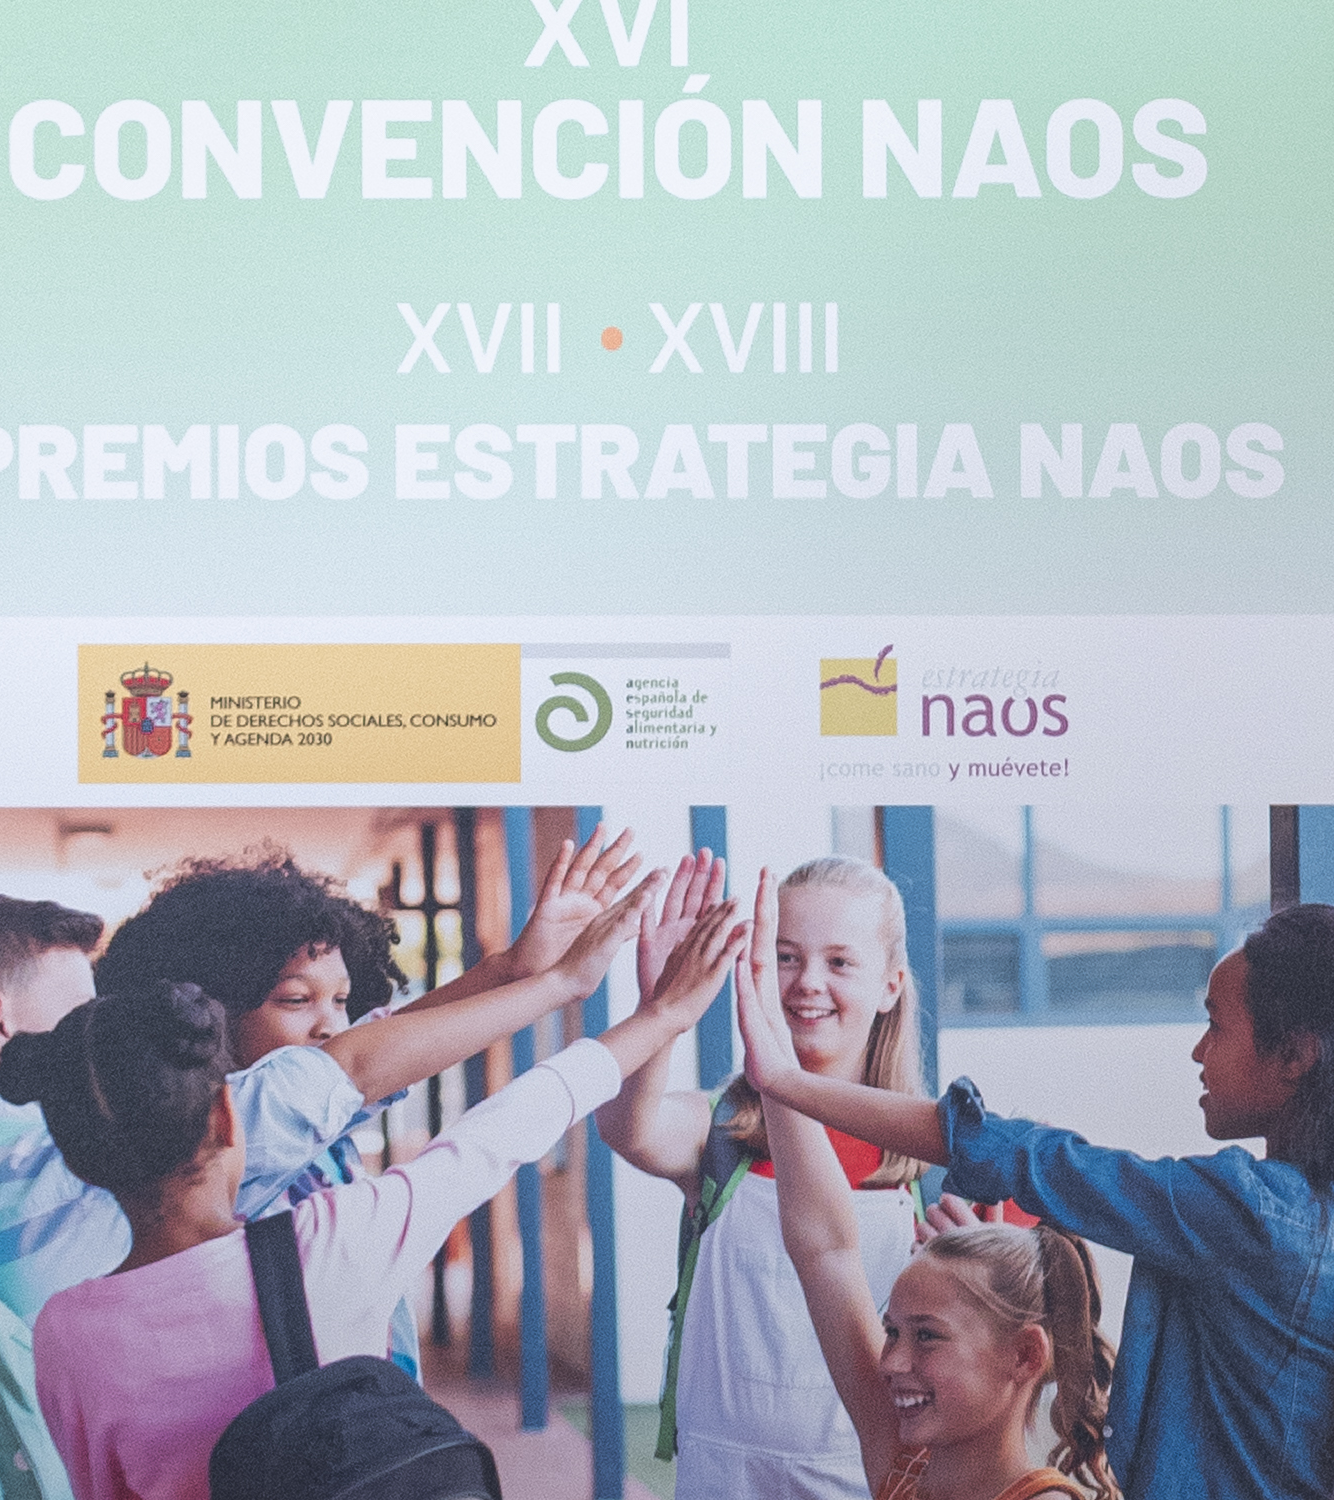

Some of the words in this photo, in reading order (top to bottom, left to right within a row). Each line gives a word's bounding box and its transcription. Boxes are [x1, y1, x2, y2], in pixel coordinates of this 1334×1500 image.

[9, 75, 823, 201] CONVENCIÓN
[862, 98, 1208, 200] NAOS
[397, 302, 561, 374] XVII
[649, 301, 839, 374] XVIII
[395, 422, 994, 500] ESTRATEGIA
[1020, 422, 1285, 499] NAOS
[626, 677, 679, 691] agencia
[921, 661, 1060, 697] estrategia
[210, 696, 302, 710] MINISTERIO
[626, 689, 687, 706] española
[692, 689, 708, 704] de
[210, 714, 233, 728] DE
[236, 714, 324, 728] DERECHOS
[328, 714, 407, 729] SOCIALES,
[410, 713, 497, 728] CONSUMO
[626, 704, 693, 721] seguridad
[922, 694, 1069, 737] naos
[626, 720, 705, 733] alimentaria
[710, 724, 717, 737] y
[210, 732, 221, 746] Y
[223, 732, 293, 746] AGENDA
[297, 732, 333, 746] 2030
[626, 736, 688, 749] nutrición
[948, 763, 960, 782] y
[968, 757, 1069, 777] muévete!
